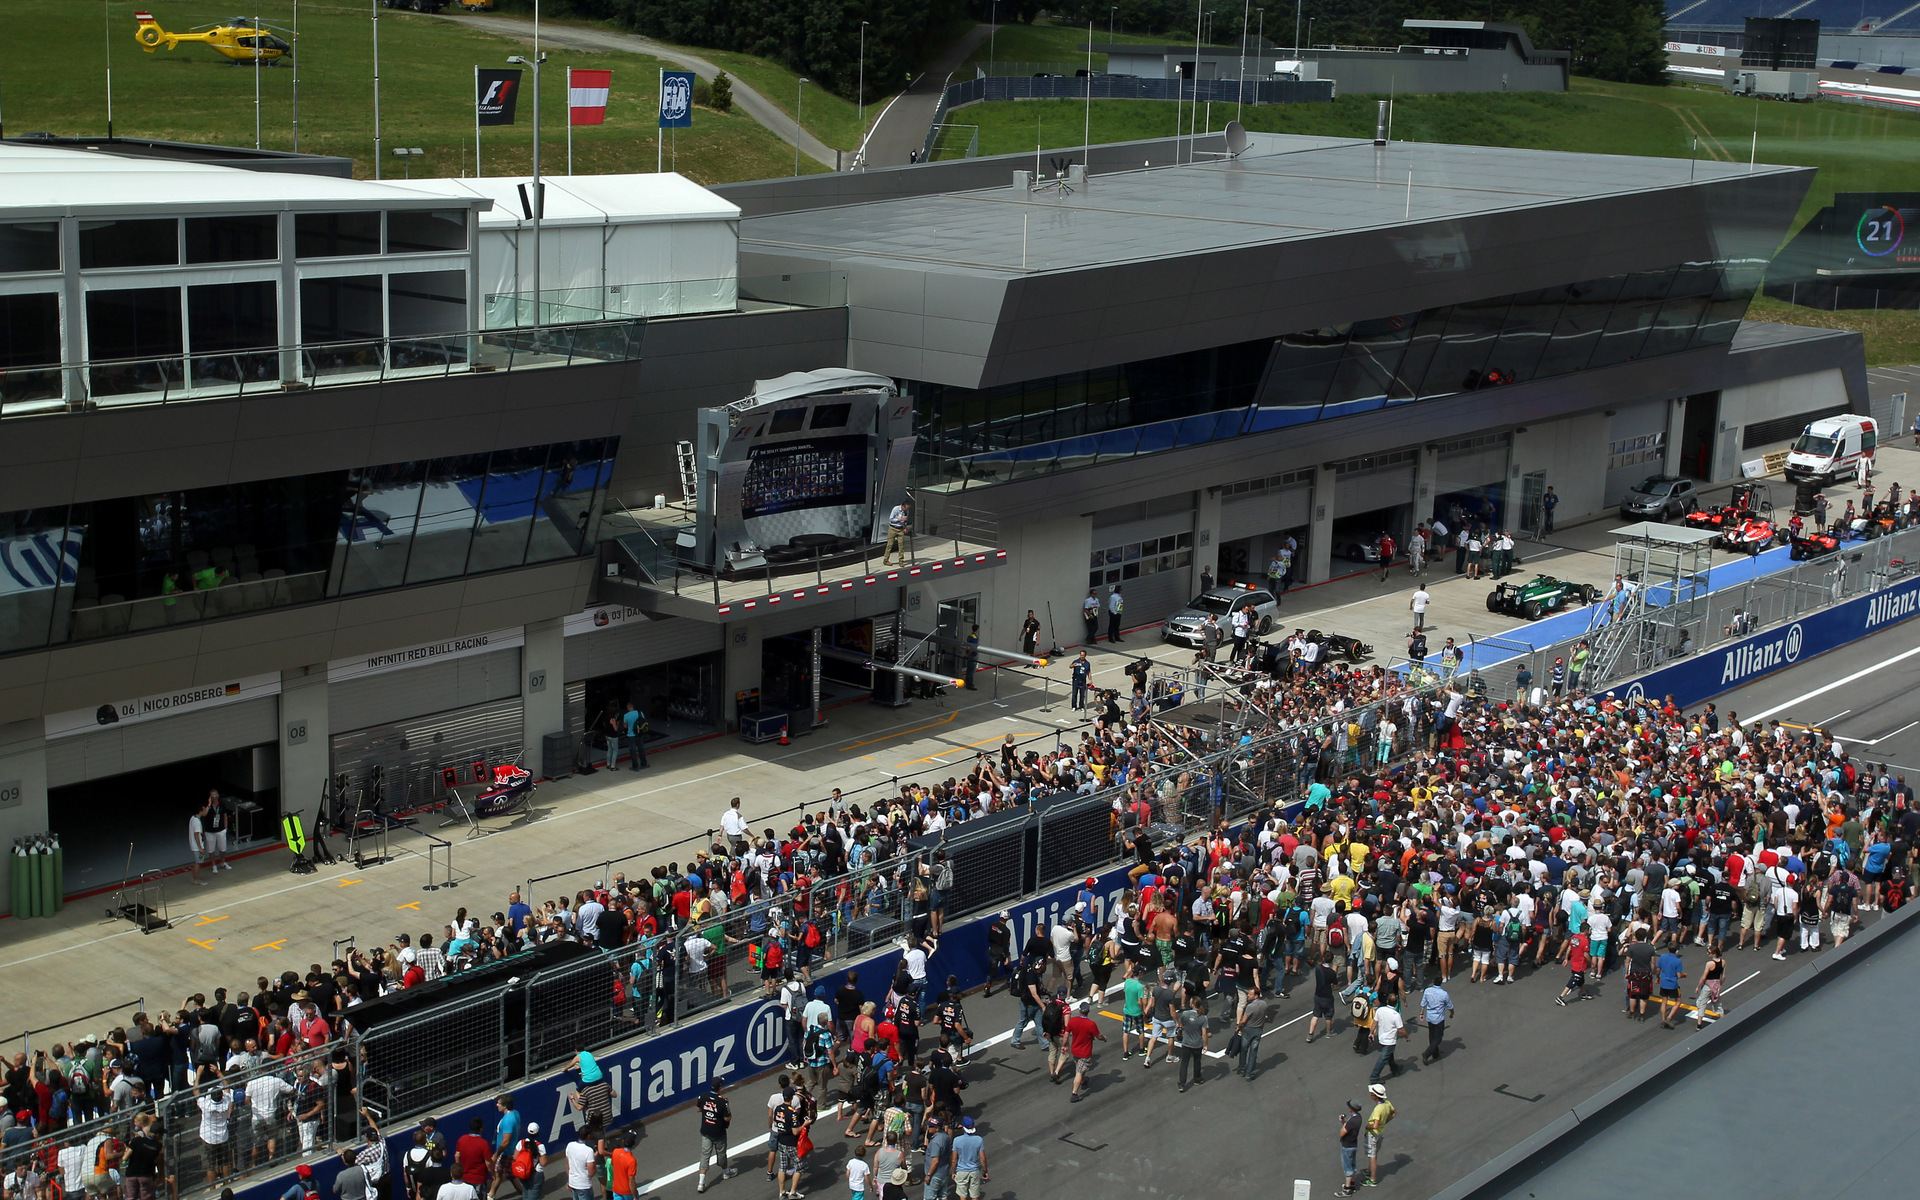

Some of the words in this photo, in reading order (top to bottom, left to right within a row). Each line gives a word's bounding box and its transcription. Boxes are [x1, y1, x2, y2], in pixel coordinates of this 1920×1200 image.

[1667, 43, 1680, 51] UBS
[1703, 46, 1717, 54] UBS
[1866, 220, 1892, 241] 21
[910, 595, 920, 606] 05
[611, 610, 621, 620] 03
[1865, 588, 1917, 629] Allianz
[735, 633, 746, 644] 06
[367, 651, 406, 668] INFINITI
[408, 647, 427, 660] RED
[429, 643, 453, 656] BULL
[455, 636, 488, 652] RACING
[1721, 639, 1784, 685] Allianz
[531, 675, 545, 687] 07
[122, 704, 135, 716] 06
[143, 697, 170, 712] NICO
[172, 687, 223, 706] ROSBERG
[290, 726, 306, 738] 08
[1, 787, 20, 801] 09
[548, 1034, 735, 1143] Alianz
